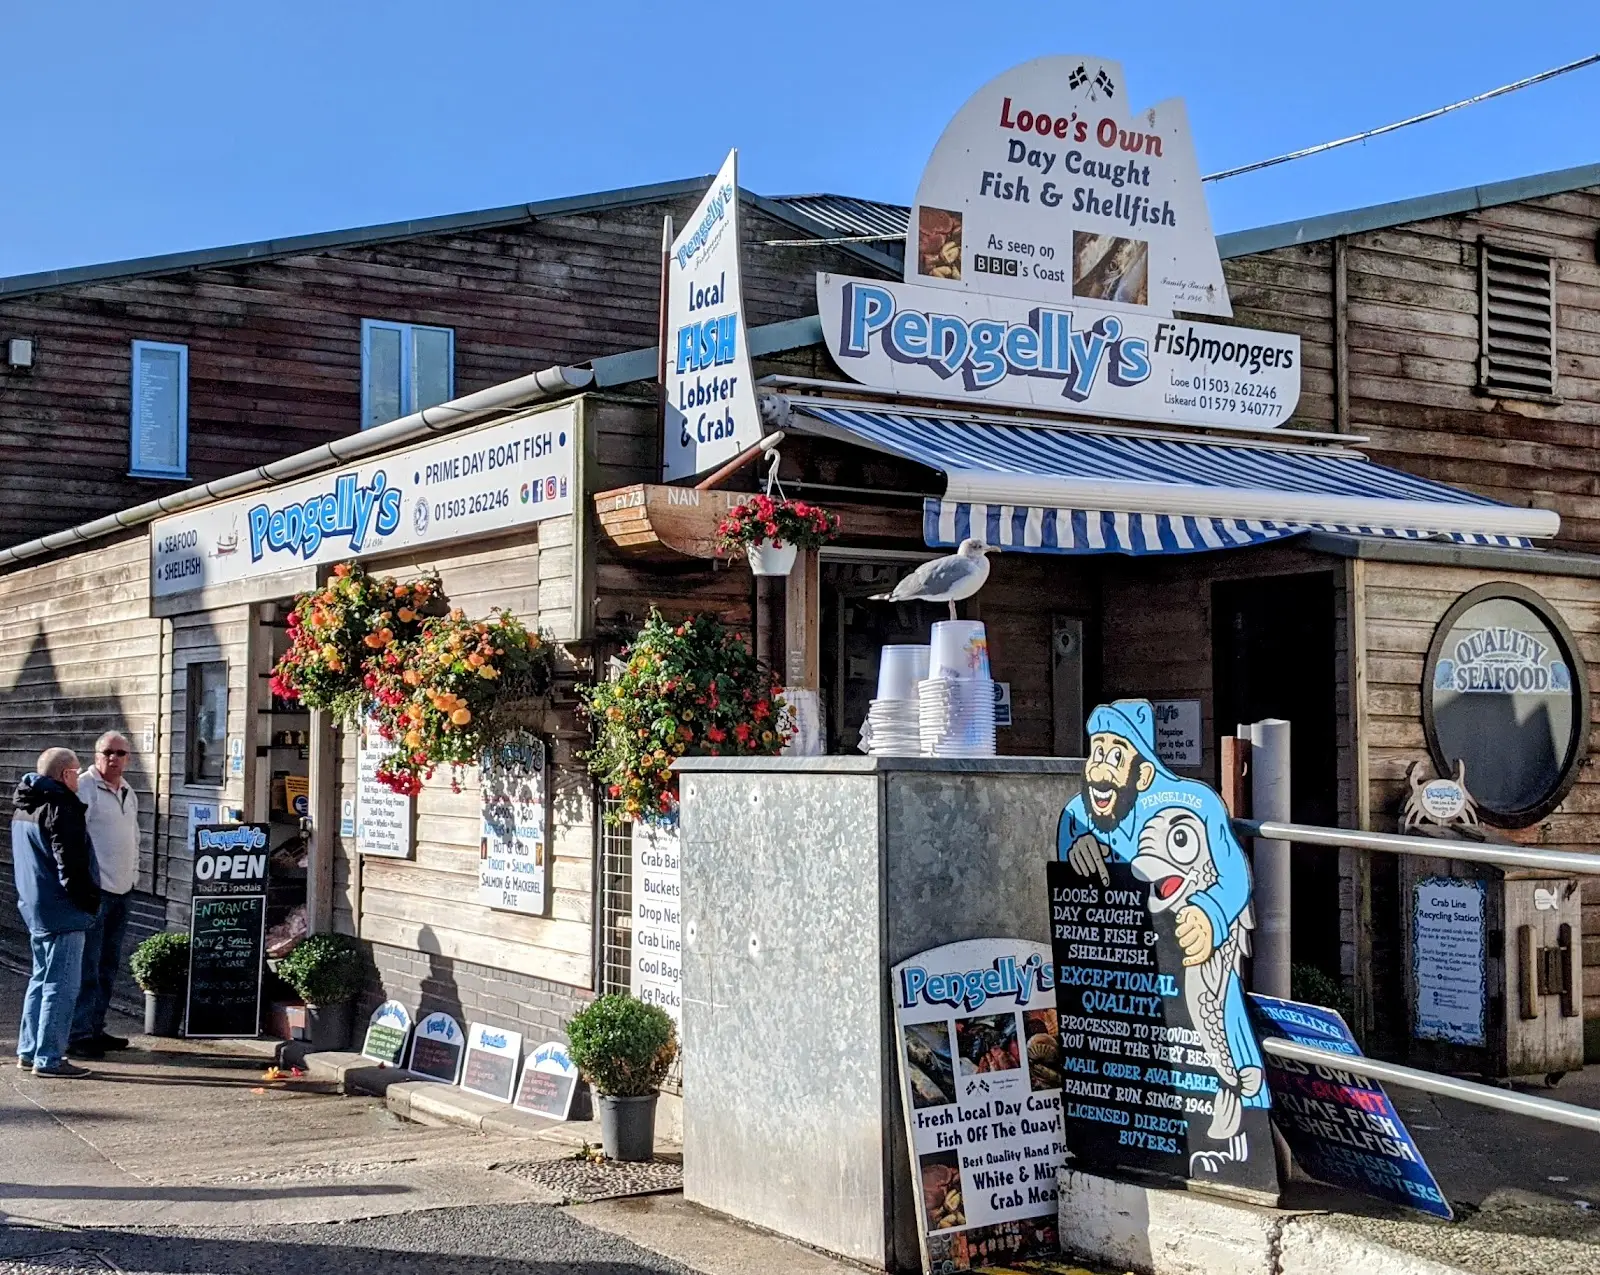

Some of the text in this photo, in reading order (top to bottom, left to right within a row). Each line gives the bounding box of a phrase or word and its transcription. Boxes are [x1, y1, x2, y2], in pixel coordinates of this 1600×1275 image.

[1000, 97, 1162, 157] Looe's Own
[1008, 138, 1150, 187] Day Caught
[980, 171, 1176, 227] Fish & Shellfish
[677, 183, 732, 270] Pengelly's
[988, 234, 1054, 258] As seen on
[974, 254, 1065, 282] BBC's Coast
[689, 271, 725, 312] Local
[1160, 276, 1187, 289] Family
[676, 312, 737, 374] FISH
[839, 281, 1151, 402] Pengelly's
[1154, 323, 1294, 375] Fishmongers
[679, 375, 738, 411] Lobster
[1170, 374, 1278, 400] Looe 01503 262246
[1164, 393, 1283, 418] Liskeard 01579 340777
[680, 412, 734, 447] & Crab
[425, 431, 552, 486] PRIME DAY BOAT FISH
[434, 498, 466, 521] 01503
[468, 488, 509, 514] 262246
[668, 488, 699, 506] NAN
[248, 469, 402, 562] Pengelly's
[165, 529, 198, 553] SEAFOOD
[165, 557, 200, 581] SHELLFISH
[1456, 628, 1548, 665] QUALITY
[1456, 665, 1548, 691] SEAFOOD
[1175, 751, 1187, 760] Fish
[1139, 791, 1203, 810] PENGELLYS
[198, 826, 267, 852] Pengelly's
[196, 854, 267, 880] OPEN
[487, 856, 535, 875] TROUT SALMON
[641, 850, 680, 870] Crab Bai
[481, 873, 541, 894] SALMON & MACKEREL
[644, 878, 680, 897] Buckets
[1053, 884, 1142, 906] LOOE'S OWN
[195, 899, 257, 918] ENTRANCE
[503, 891, 518, 907] PATE
[1431, 899, 1467, 909] Crab Line
[212, 917, 238, 927] ONLY
[639, 903, 662, 924] Drop
[1053, 906, 1145, 926] DAY CAUGHT
[1419, 909, 1479, 923] Recycling Station
[214, 935, 224, 949] 2
[638, 930, 659, 947] Crab
[1055, 924, 1159, 947] PRIME FISH &
[638, 957, 659, 976] Cool
[1067, 944, 1155, 967] SHELLFISH.
[901, 953, 1056, 1013] Pengelly's
[1060, 965, 1179, 997] EXCEPTIONAL
[640, 984, 680, 1007] Ice Packs
[1081, 990, 1161, 1018] QUALITY.
[1060, 1014, 1202, 1046] PROCESSED TO PROVIDE
[1060, 1032, 1084, 1048] YOU
[1088, 1036, 1121, 1055] WITH
[1124, 1041, 1150, 1058] THE
[1152, 1043, 1185, 1063] VERY
[1063, 1056, 1219, 1093] MAIL ORDER AVAILABLE
[1065, 1079, 1112, 1099] FAMILY
[1115, 1087, 1142, 1105] RUN
[1145, 1091, 1182, 1110] SINCE
[918, 1108, 953, 1128] Fresh
[957, 1102, 991, 1122] Local
[995, 1097, 1022, 1117] Day
[1067, 1102, 1188, 1136] LICENSED DIRECT
[1343, 1107, 1401, 1139] FISH
[937, 1129, 963, 1148] Fish
[991, 1121, 1016, 1139] The
[1021, 1114, 1062, 1136] Quay!
[1118, 1130, 1182, 1155] BUYERS.
[1294, 1114, 1418, 1162] SHELLFISH
[963, 1155, 983, 1169] Best
[986, 1149, 1021, 1165] Quality
[1024, 1144, 1050, 1160] Hand
[973, 1167, 1014, 1190] White
[1019, 1165, 1030, 1182] &
[990, 1190, 1024, 1211] Crab
